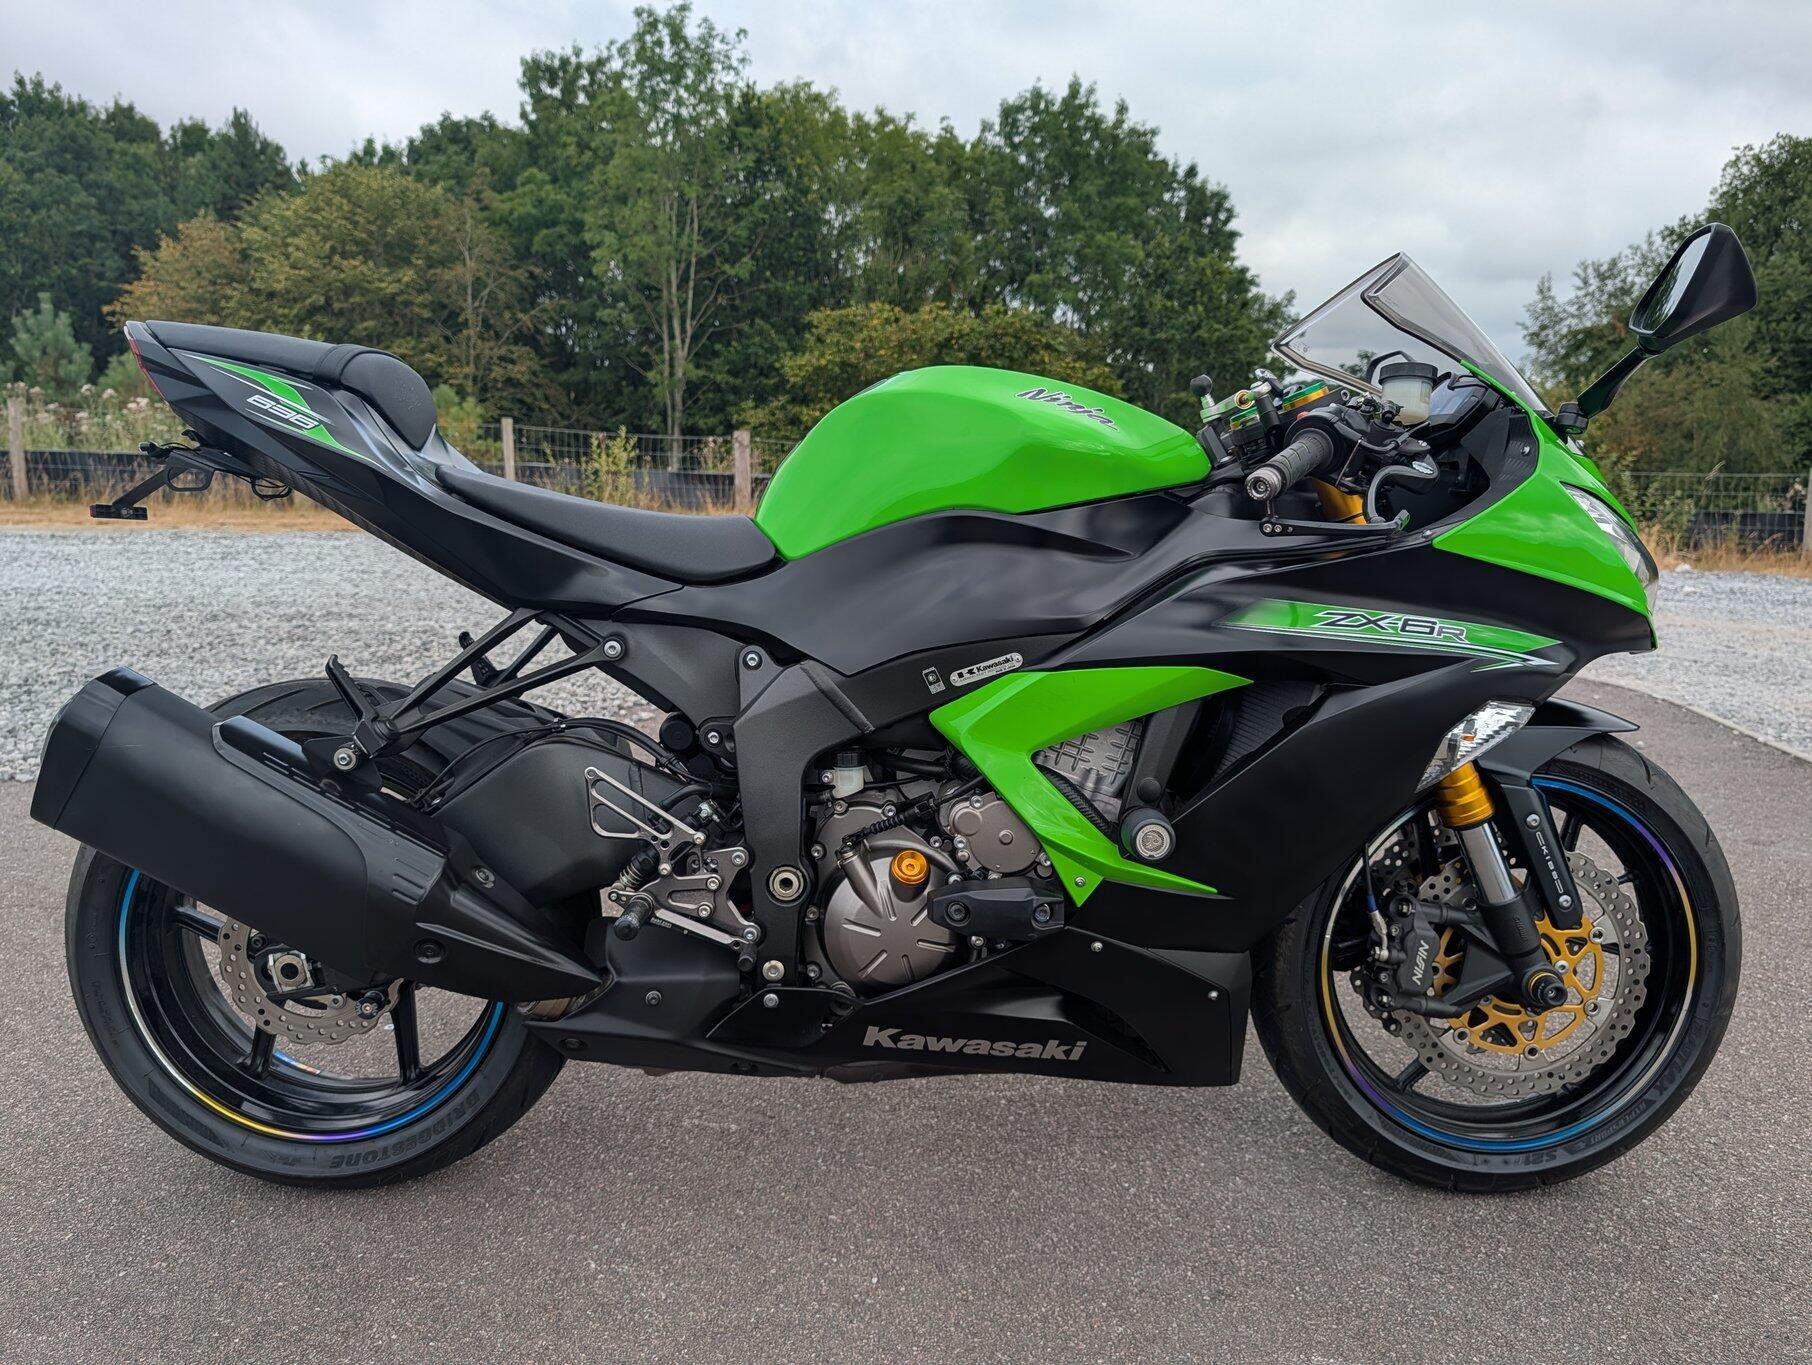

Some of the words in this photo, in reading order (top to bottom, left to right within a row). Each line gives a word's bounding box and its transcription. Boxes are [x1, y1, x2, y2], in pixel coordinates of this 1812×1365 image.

[246, 394, 320, 430] 636
[1015, 387, 1119, 431] Ninja
[1310, 610, 1470, 644] ZX-6R
[976, 655, 1014, 673] Kawasaki
[862, 1025, 1088, 1061] Kawasaki
[328, 1091, 481, 1169] BRIDGESTONE
